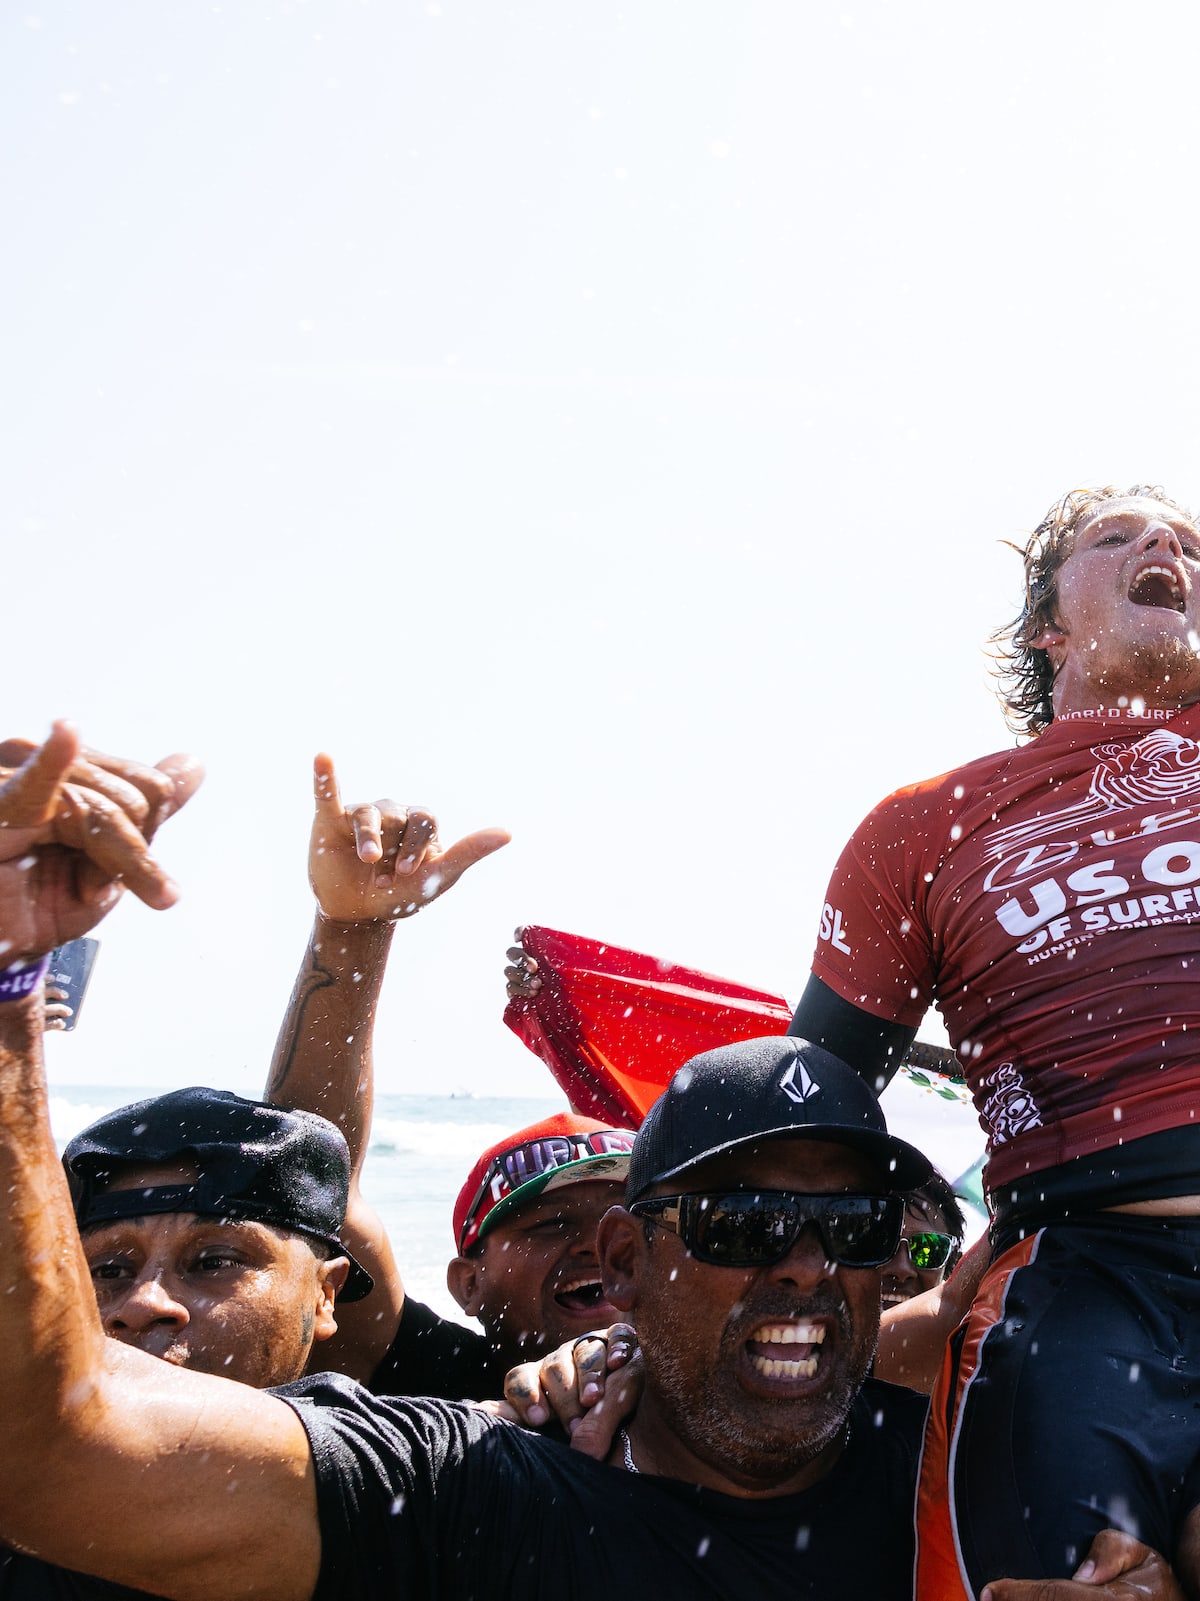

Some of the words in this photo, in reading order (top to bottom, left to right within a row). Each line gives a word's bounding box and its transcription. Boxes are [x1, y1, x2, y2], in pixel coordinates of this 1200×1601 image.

[1058, 708, 1120, 721] WORLD
[1126, 708, 1174, 720] SURF
[996, 859, 1130, 937] US
[1015, 915, 1072, 954] OF
[1027, 919, 1149, 966] HUNTINGTON
